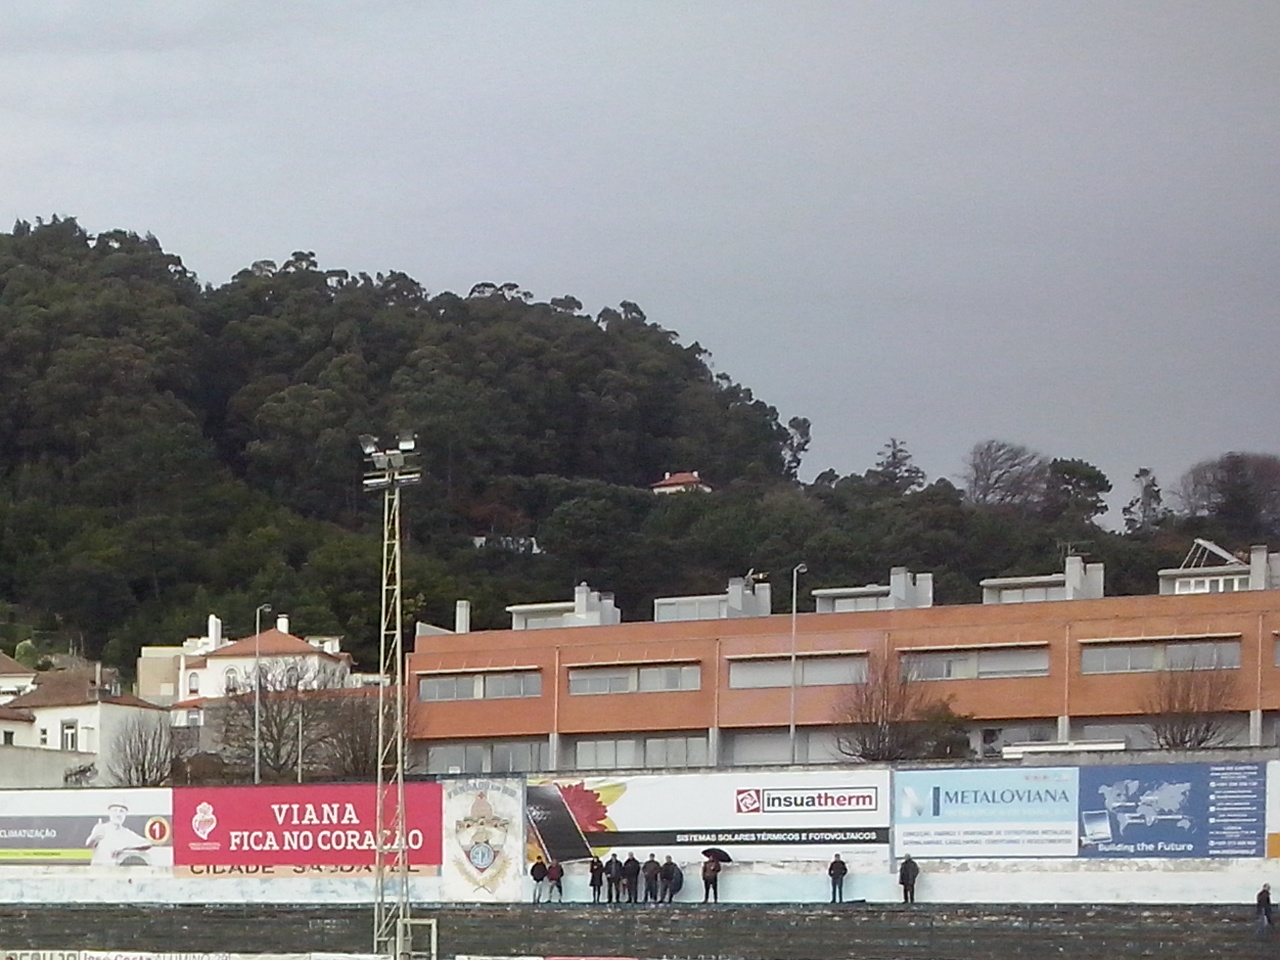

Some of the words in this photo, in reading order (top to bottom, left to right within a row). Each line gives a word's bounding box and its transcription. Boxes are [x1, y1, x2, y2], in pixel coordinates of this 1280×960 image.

[766, 791, 873, 808] insuatherm
[944, 789, 1069, 804] METALOVIANA
[270, 803, 360, 825] VIANA
[229, 831, 280, 851] FICA
[282, 831, 314, 850] NO
[676, 834, 717, 842] SISTEMAS
[718, 833, 756, 842] SOLARES
[808, 831, 876, 841] FOTOVOLTAICOS
[1098, 842, 1134, 853] Building
[1136, 842, 1155, 851] the
[1157, 841, 1194, 851] Future
